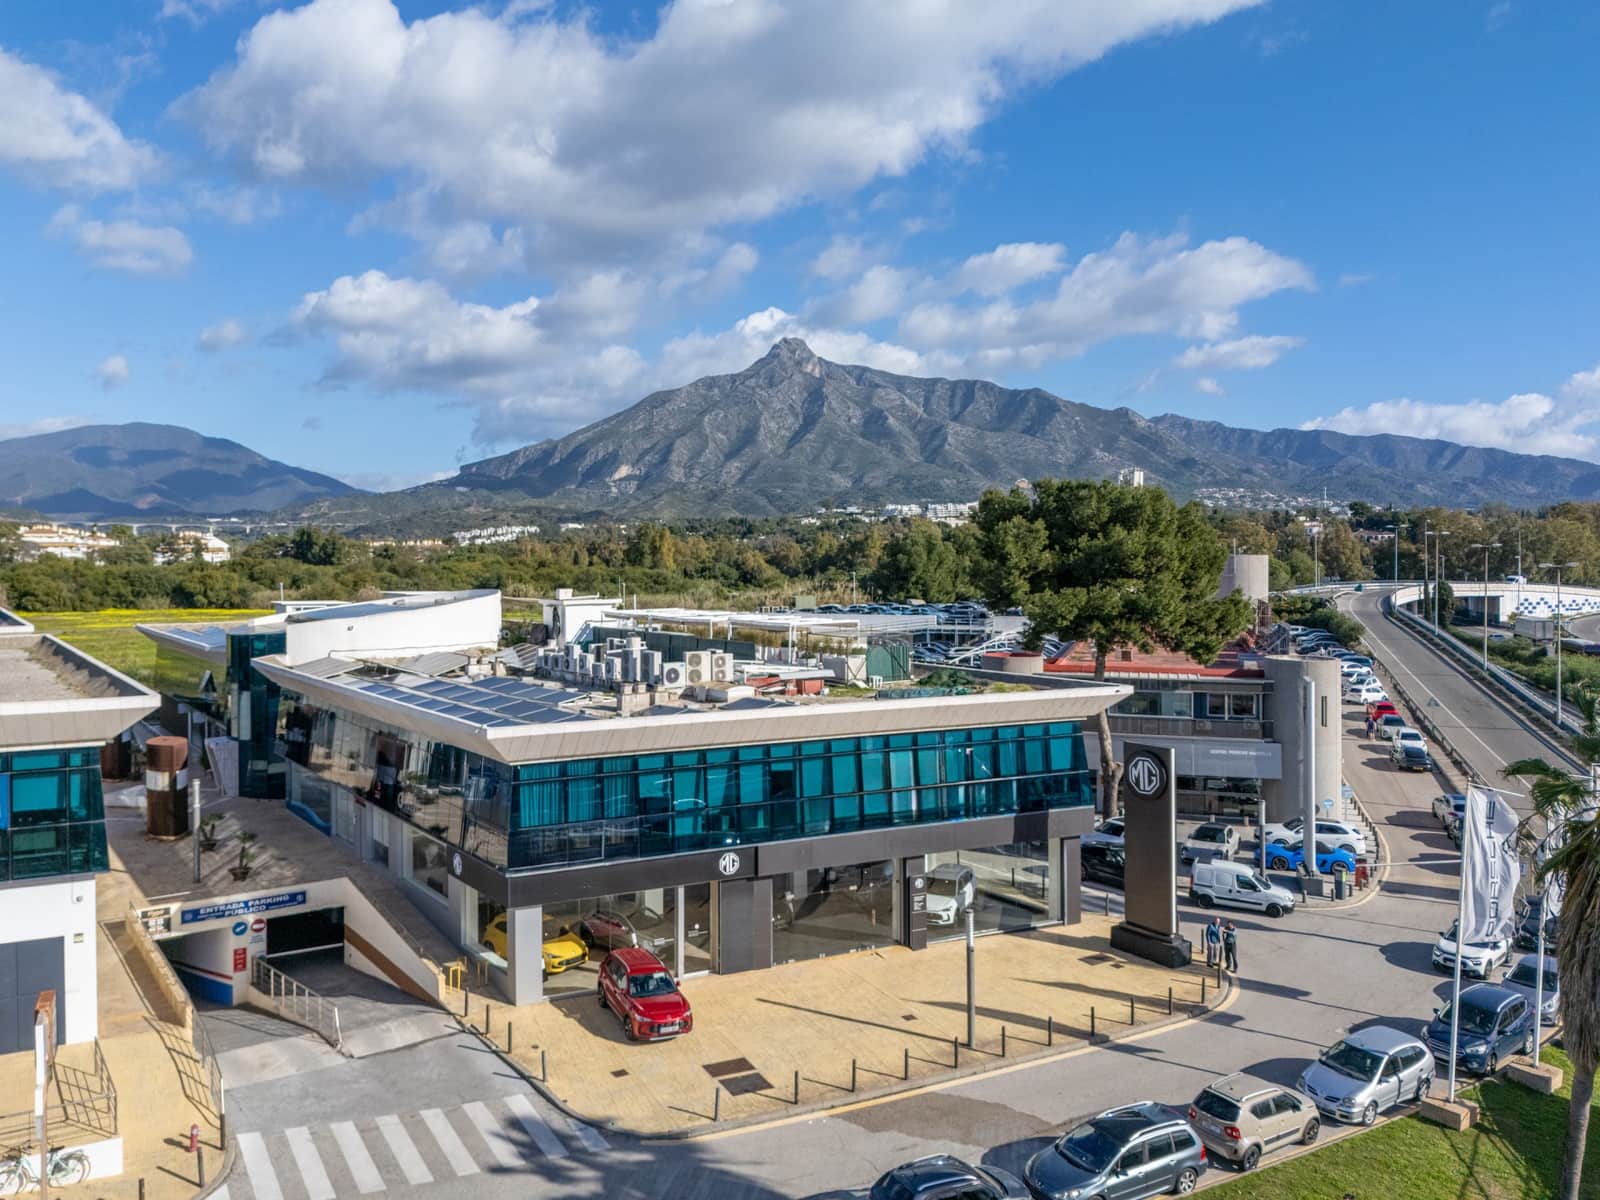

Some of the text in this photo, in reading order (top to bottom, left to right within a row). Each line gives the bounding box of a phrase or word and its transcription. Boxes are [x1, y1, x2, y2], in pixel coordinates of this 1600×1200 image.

[1130, 758, 1158, 792] MG
[720, 853, 739, 874] MG
[1486, 800, 1498, 937] PORSCHE
[200, 902, 245, 914] ENTRADA
[247, 894, 289, 906] PARKING
